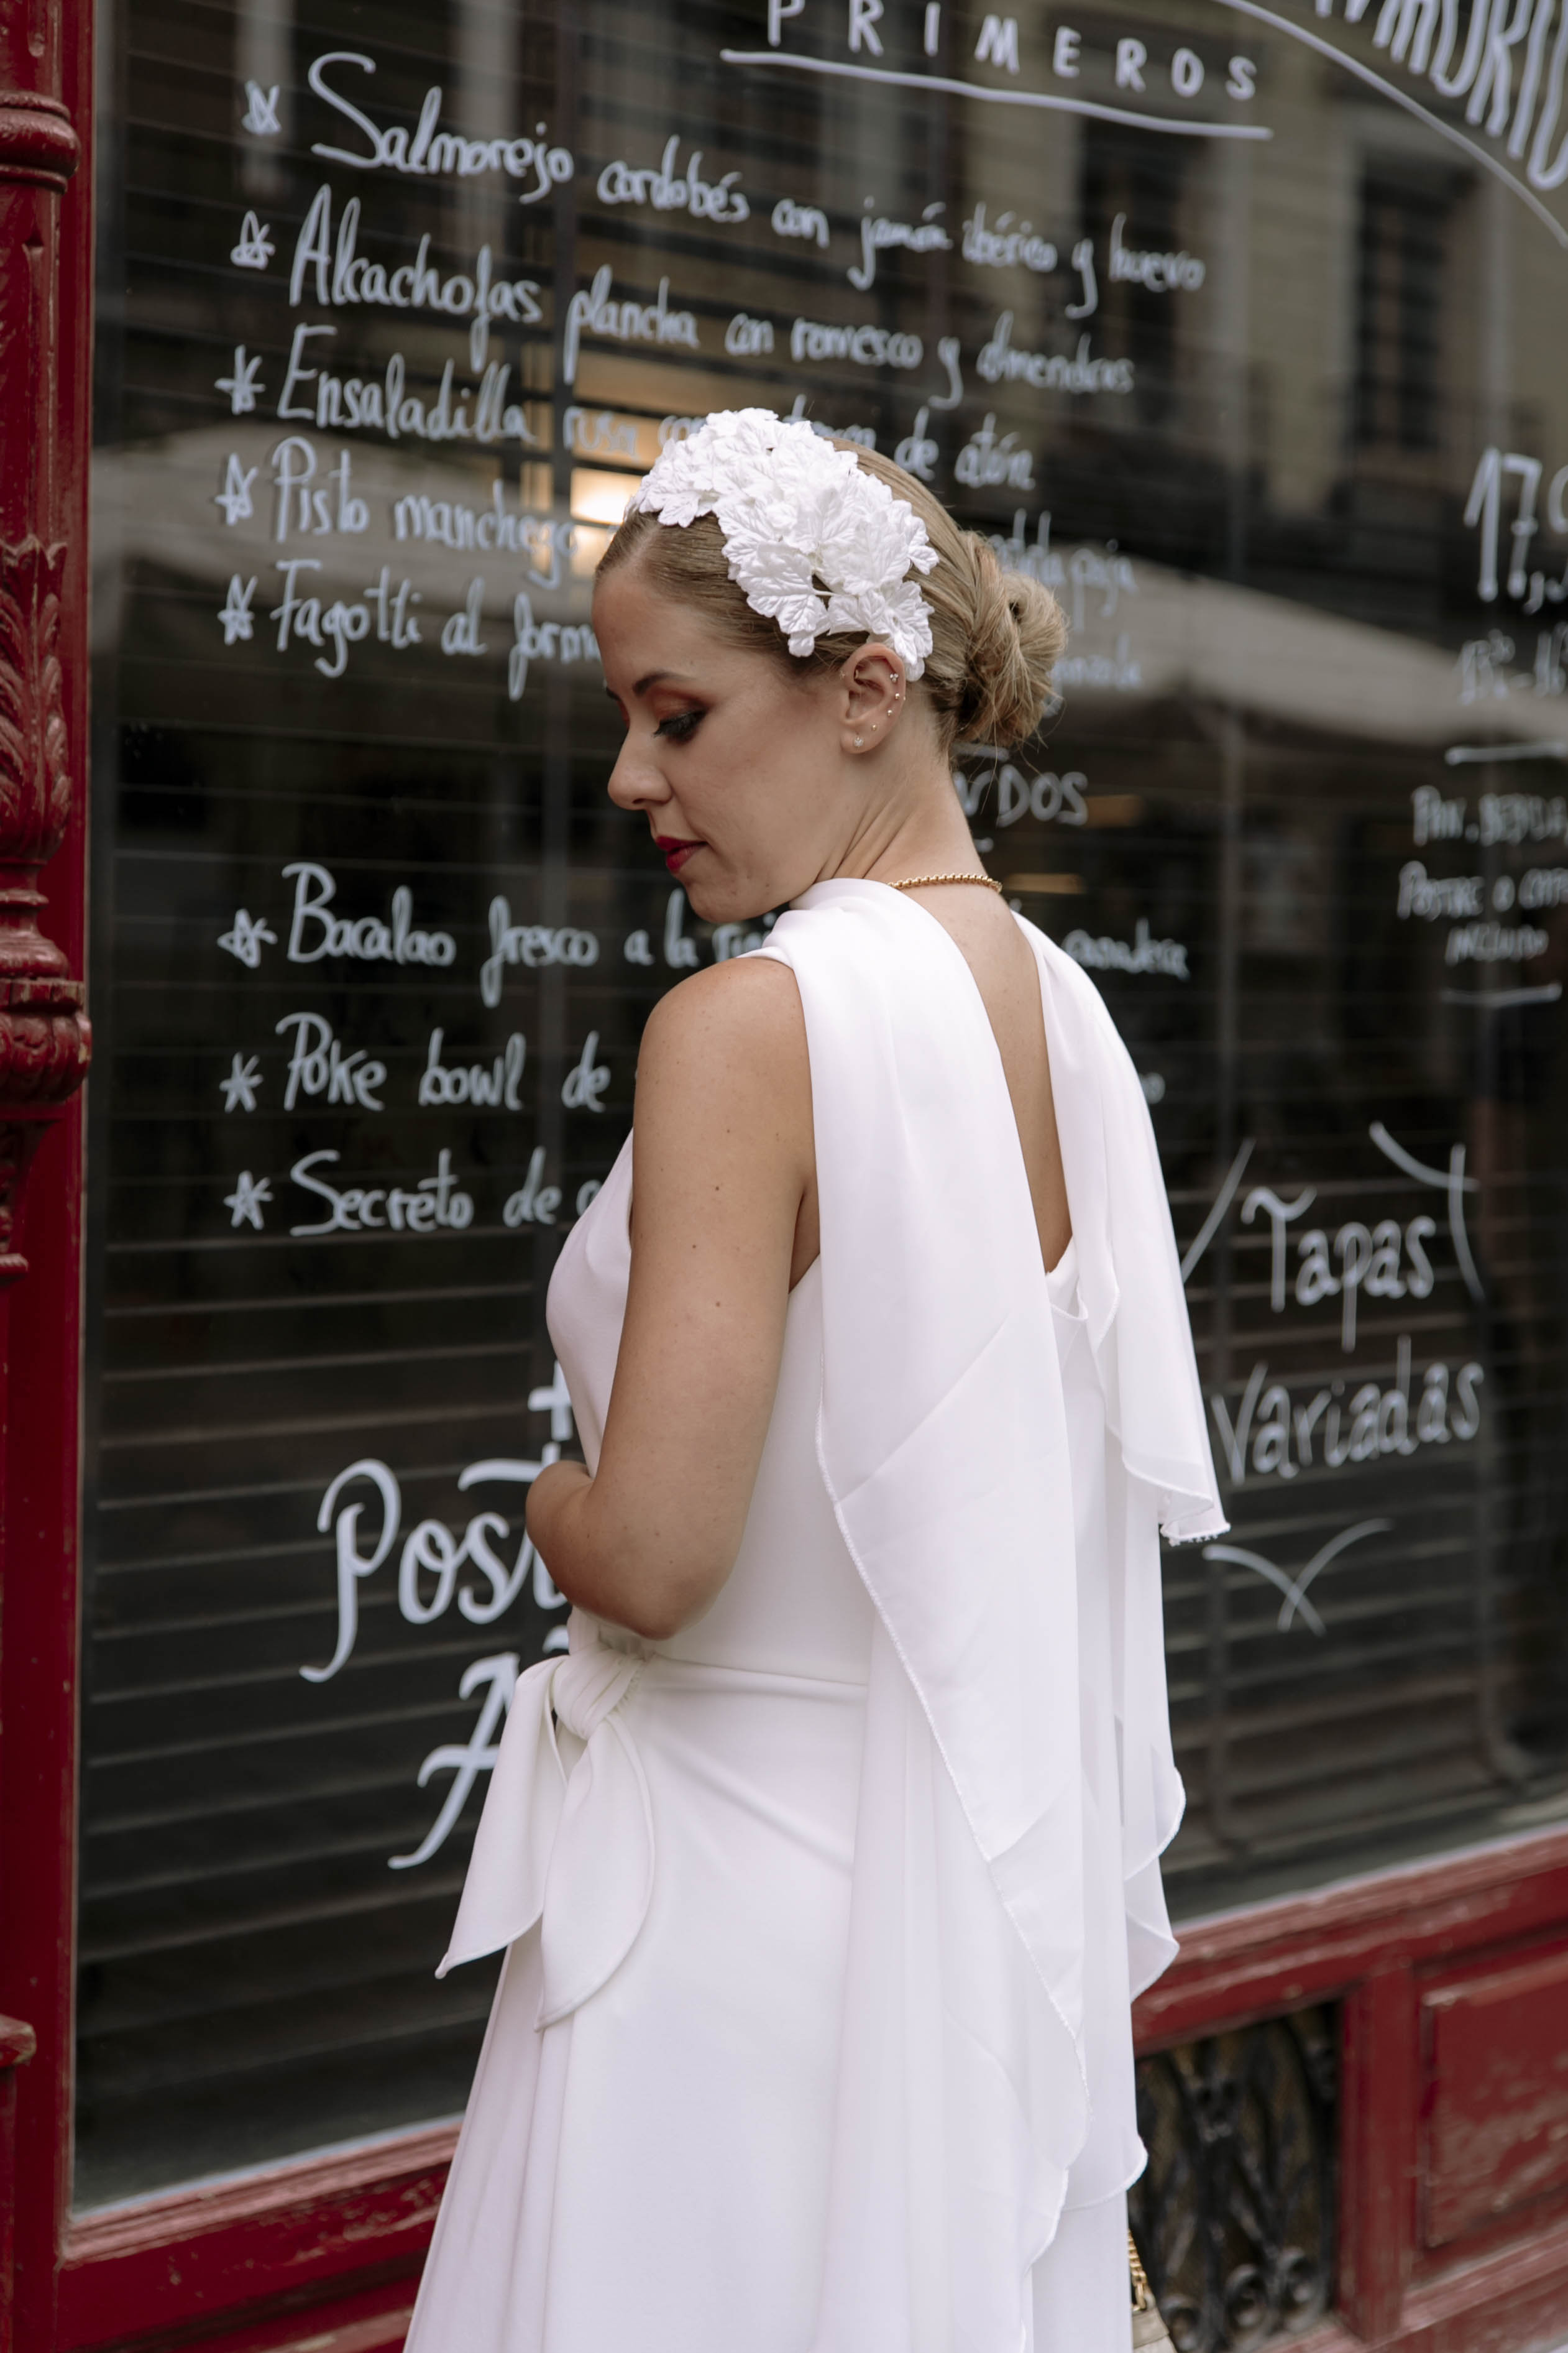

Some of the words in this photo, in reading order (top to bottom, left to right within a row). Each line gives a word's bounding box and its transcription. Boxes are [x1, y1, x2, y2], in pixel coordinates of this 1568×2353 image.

[768, 0, 1257, 100] PRIMEROS
[308, 52, 574, 204] Salmorejo
[597, 136, 749, 222] cordobés
[772, 199, 830, 247] con
[847, 196, 953, 291] jamón
[963, 202, 1058, 272] ibérico
[1065, 239, 1099, 319] y
[1109, 213, 1205, 291] huevo
[290, 184, 542, 373] Alcachofas
[564, 265, 699, 385] plancha
[725, 313, 775, 355] con
[791, 318, 924, 369] romesco
[929, 336, 963, 409] y
[277, 324, 537, 440] Ensaladilla
[272, 436, 369, 542] Pisto
[394, 480, 578, 589] manchego
[271, 559, 423, 678] Fagotti
[442, 577, 488, 655] al
[282, 862, 457, 967] Bacalao
[480, 895, 600, 1008] fresco
[625, 929, 655, 966] a
[664, 888, 700, 969] la
[275, 1013, 387, 1112] Poke
[419, 1028, 527, 1111] bowl
[562, 1030, 611, 1113] de
[290, 1149, 474, 1236] Secreto
[503, 1146, 562, 1227] de
[1242, 1187, 1436, 1353] Tapas
[1211, 1334, 1483, 1486] Variadas
